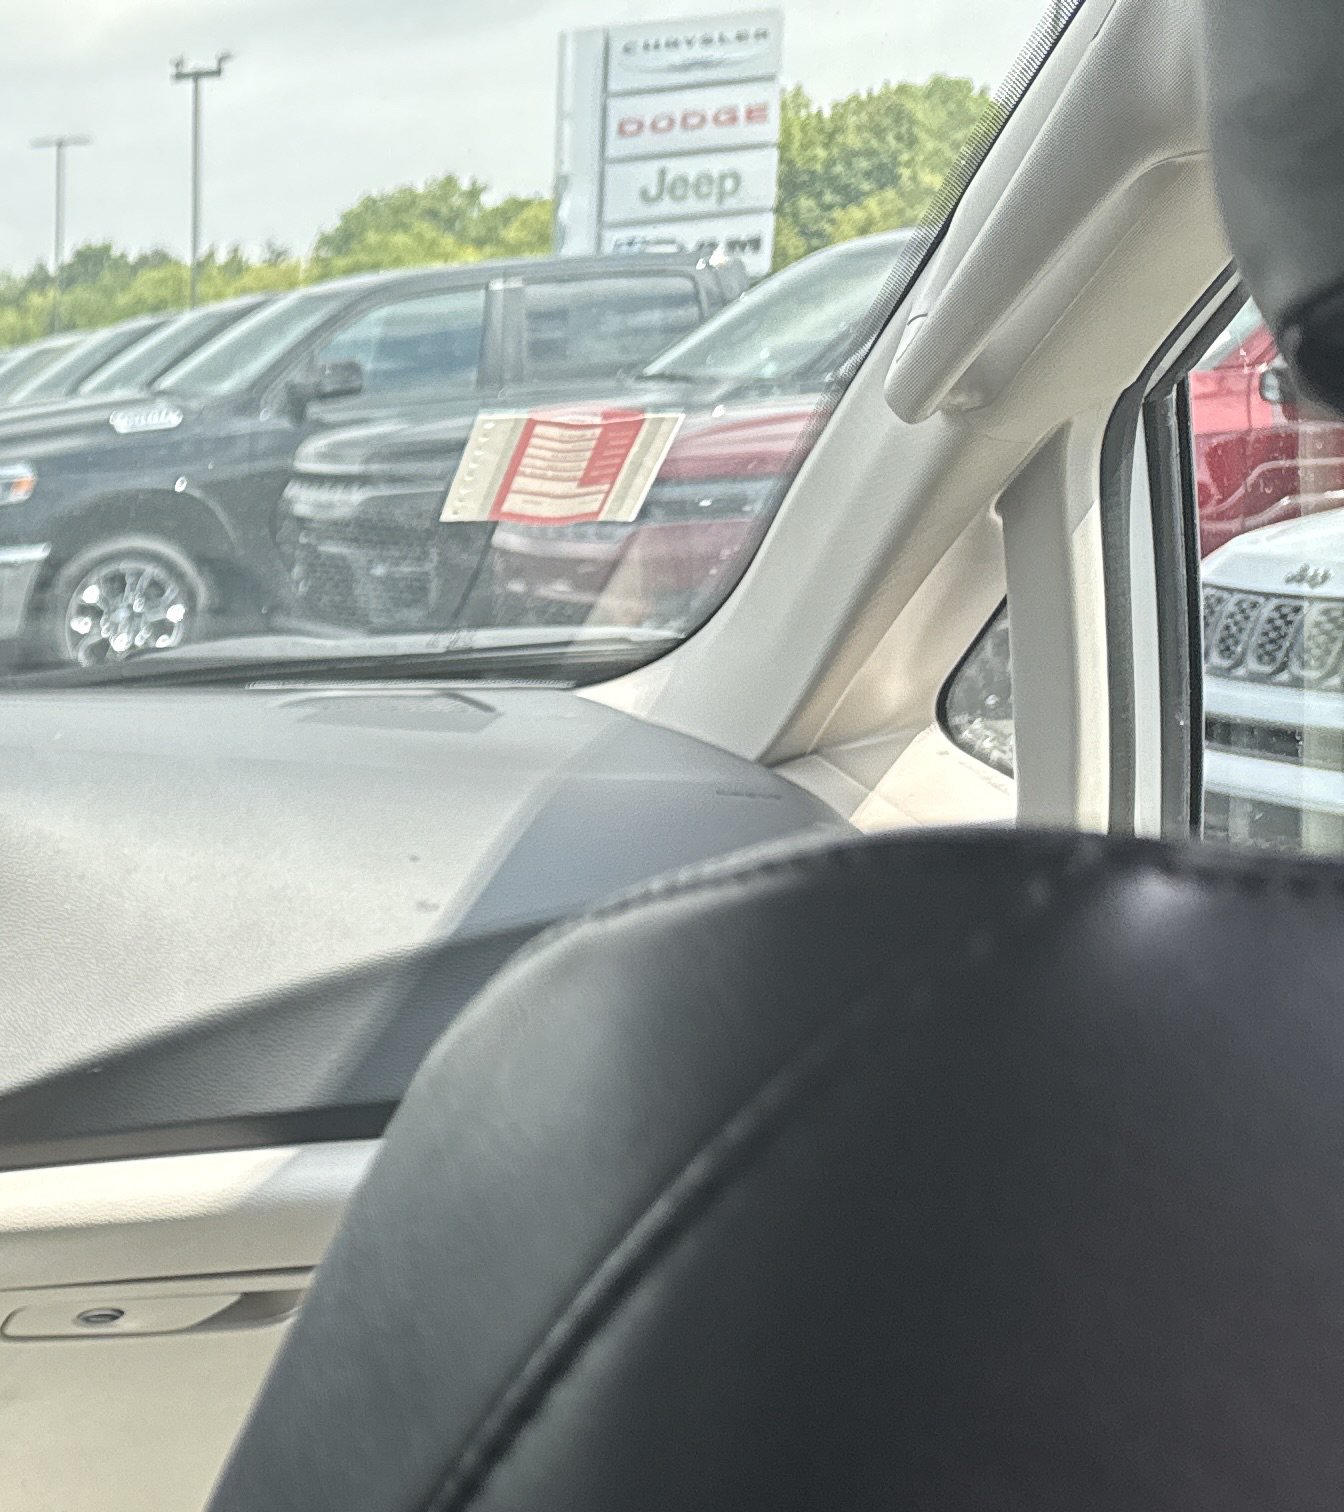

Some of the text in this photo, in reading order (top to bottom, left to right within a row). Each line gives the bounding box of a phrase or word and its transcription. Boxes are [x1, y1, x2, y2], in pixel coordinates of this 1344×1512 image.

[622, 28, 770, 55] CHRYSLER
[617, 102, 768, 138] DODGE
[639, 166, 742, 206] Jeep
